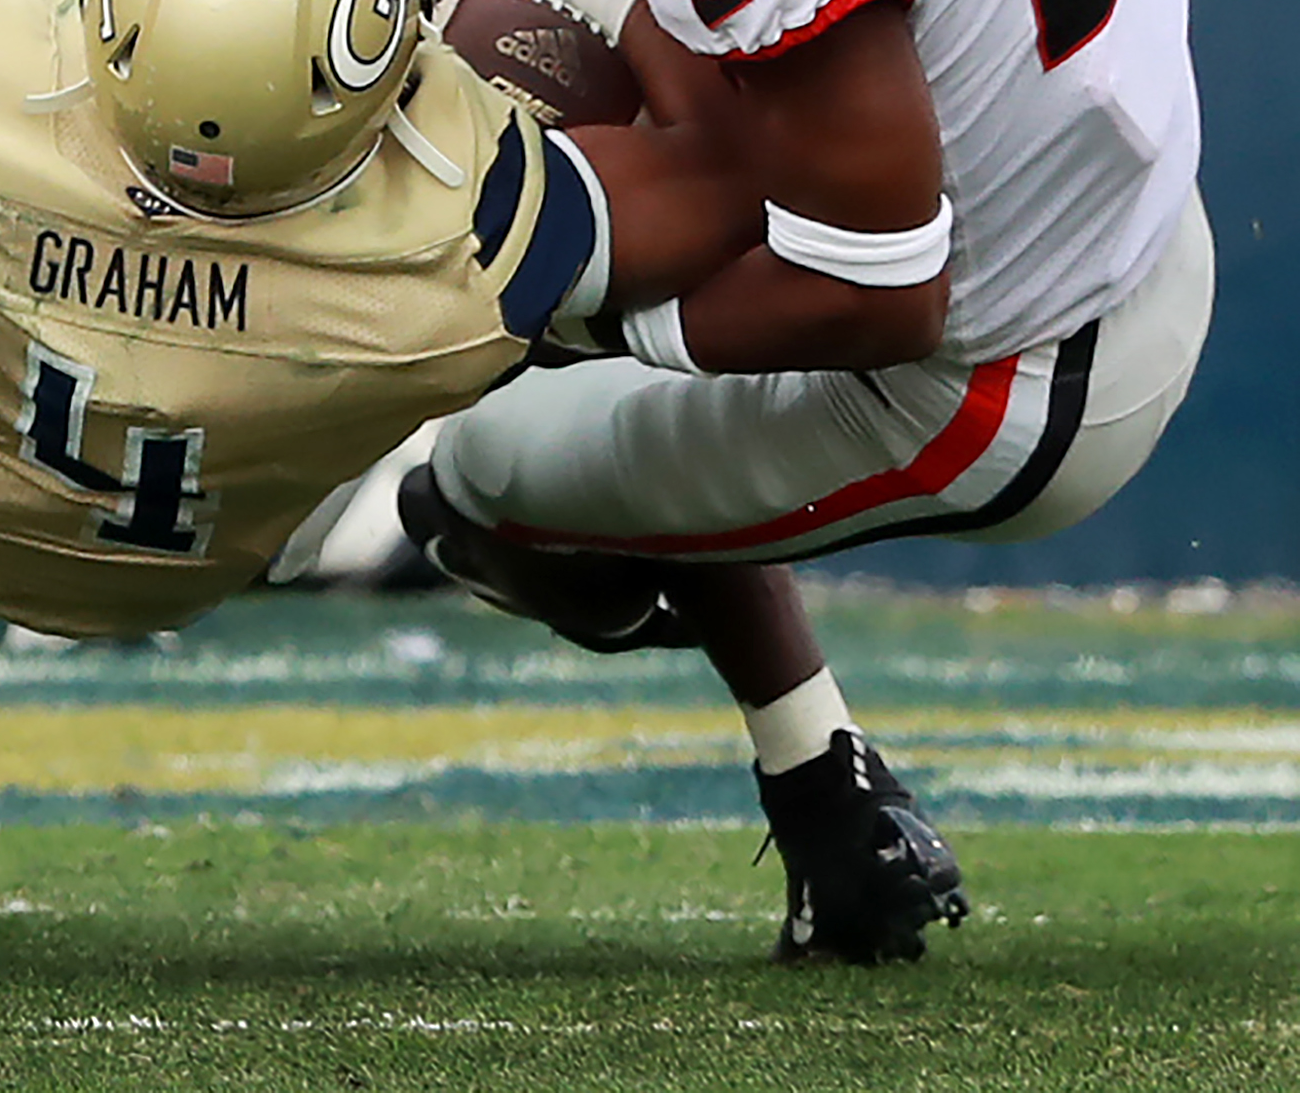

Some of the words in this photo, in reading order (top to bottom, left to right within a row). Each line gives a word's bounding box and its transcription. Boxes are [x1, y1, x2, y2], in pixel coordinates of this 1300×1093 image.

[495, 33, 582, 95] adida
[28, 230, 249, 333] GRAHAM
[15, 339, 218, 557] 4
